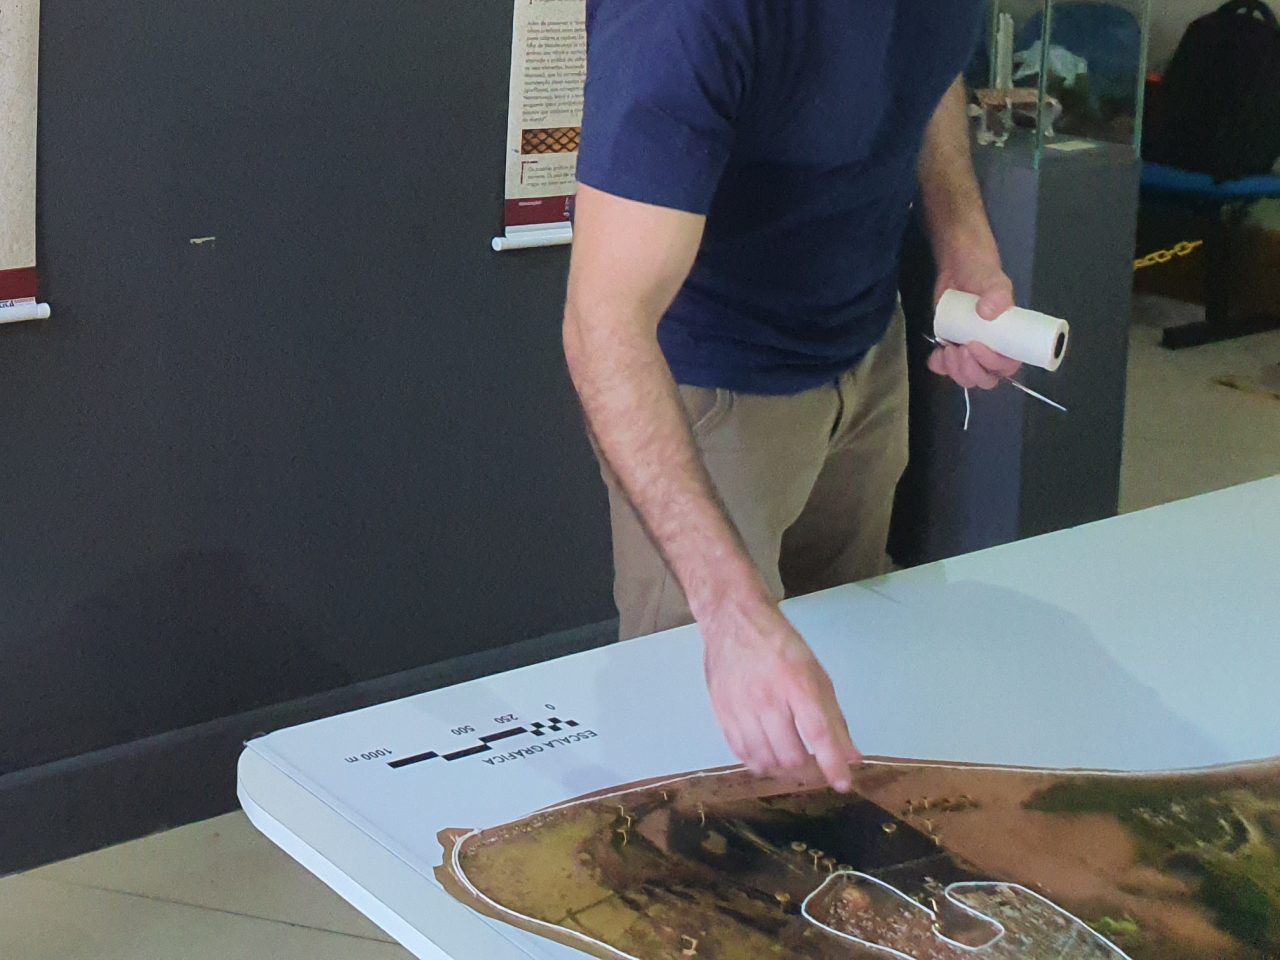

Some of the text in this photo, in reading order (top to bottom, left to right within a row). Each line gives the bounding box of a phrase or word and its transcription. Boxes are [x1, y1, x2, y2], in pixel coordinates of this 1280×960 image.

[494, 713, 518, 724] 250
[451, 725, 475, 736] 500
[481, 729, 598, 766] ESCALA GRÁFICA
[360, 747, 393, 761] 1000
